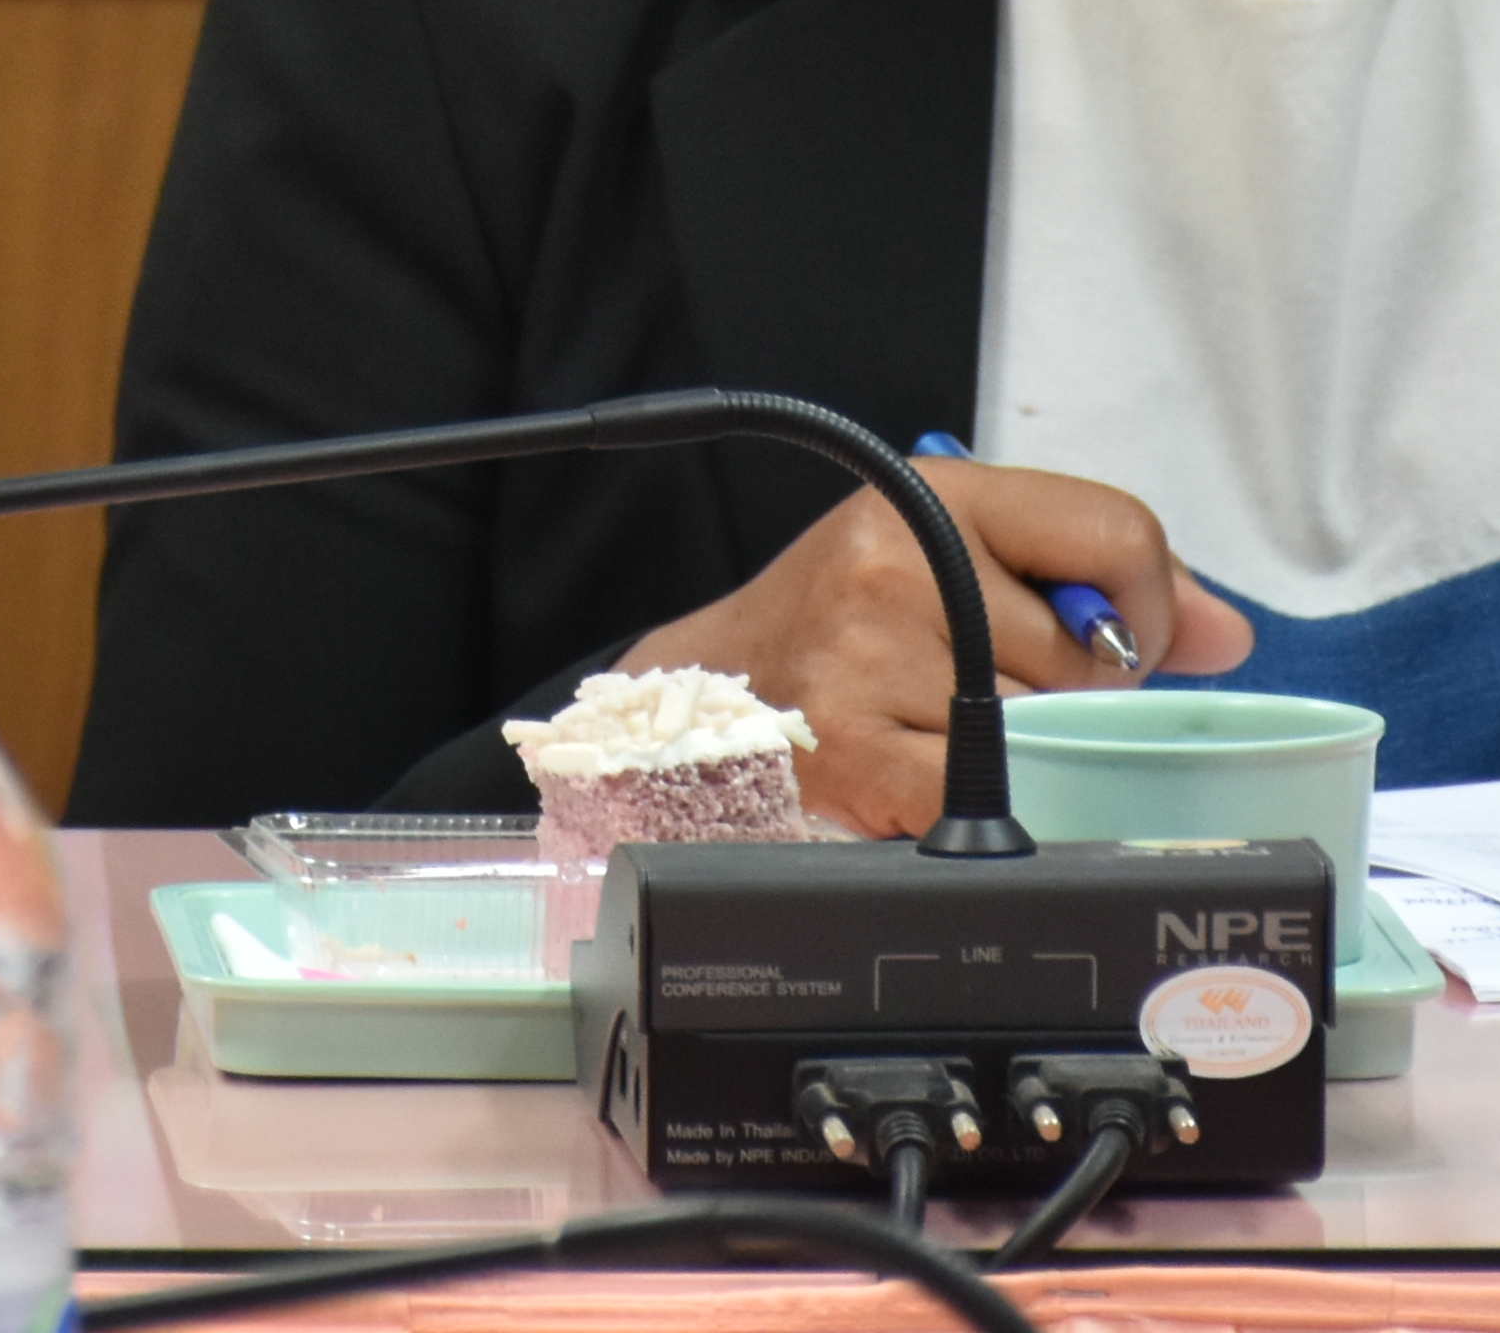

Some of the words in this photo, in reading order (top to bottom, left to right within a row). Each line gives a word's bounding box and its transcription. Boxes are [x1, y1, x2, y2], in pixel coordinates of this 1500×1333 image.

[1156, 911, 1313, 952] NPE
[961, 946, 1003, 964] LINE
[1156, 953, 1313, 967] RESEARCH
[661, 965, 785, 981] PROFESSIONAL
[661, 982, 772, 998] CONFERENCE
[776, 981, 843, 997] SYSTEM
[666, 1123, 713, 1139] Made
[666, 1148, 709, 1164] Made
[715, 1148, 734, 1168] by
[740, 1147, 776, 1164] NPE
